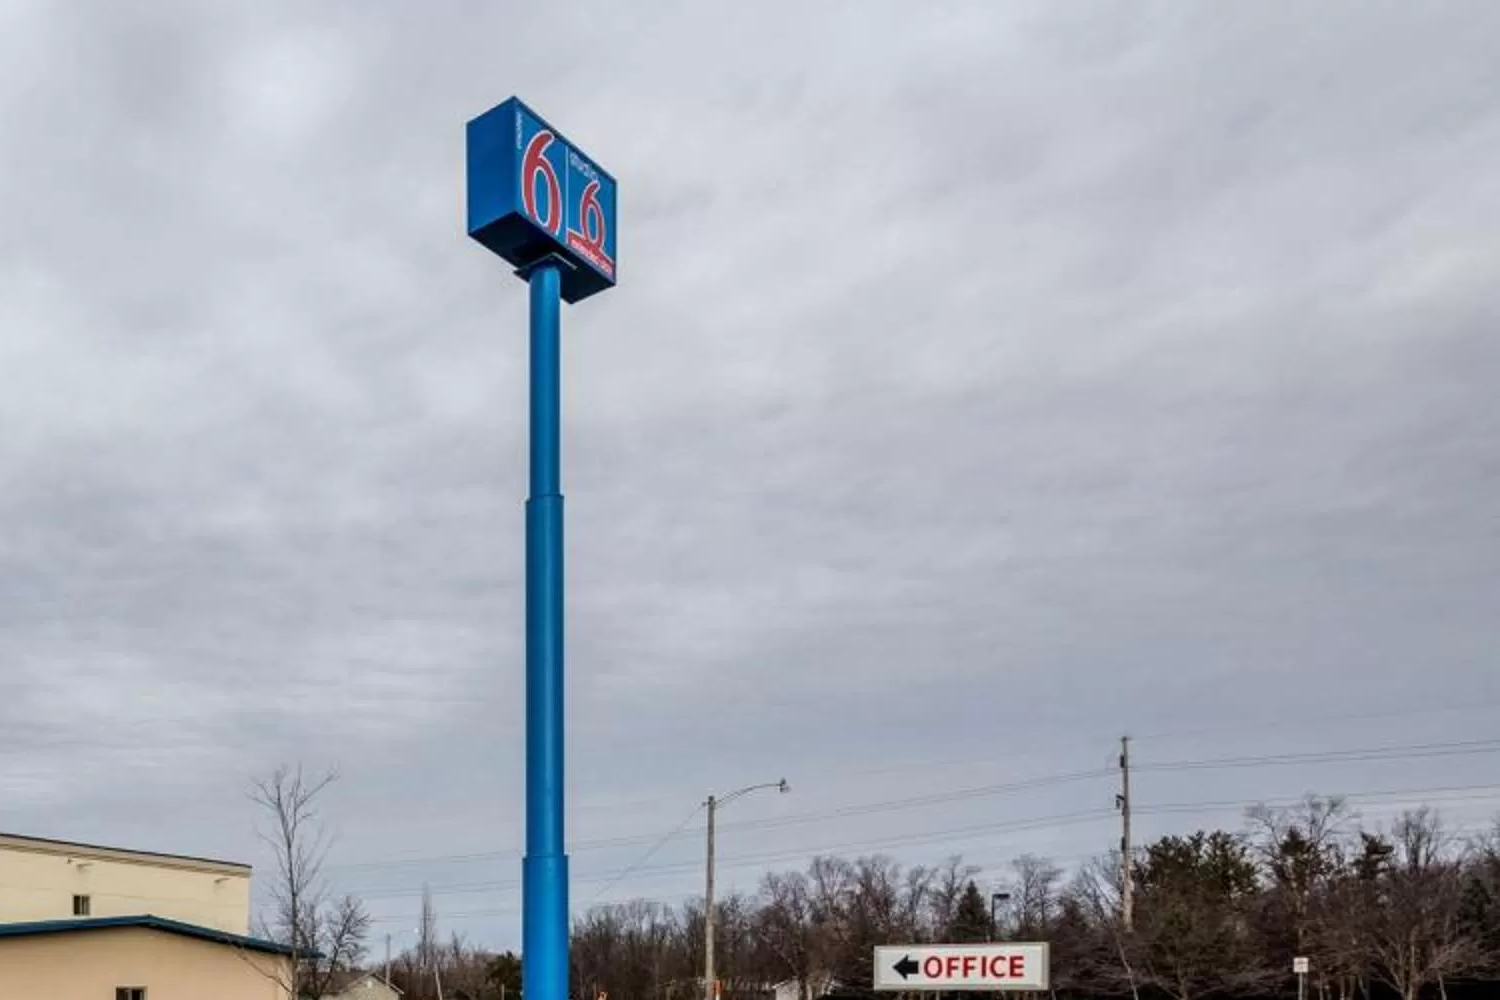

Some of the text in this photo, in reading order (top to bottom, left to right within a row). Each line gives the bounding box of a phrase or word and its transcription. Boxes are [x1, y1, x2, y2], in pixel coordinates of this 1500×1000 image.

[521, 129, 563, 236] 6
[580, 179, 605, 252] 6
[923, 955, 1025, 979] OFFICE
